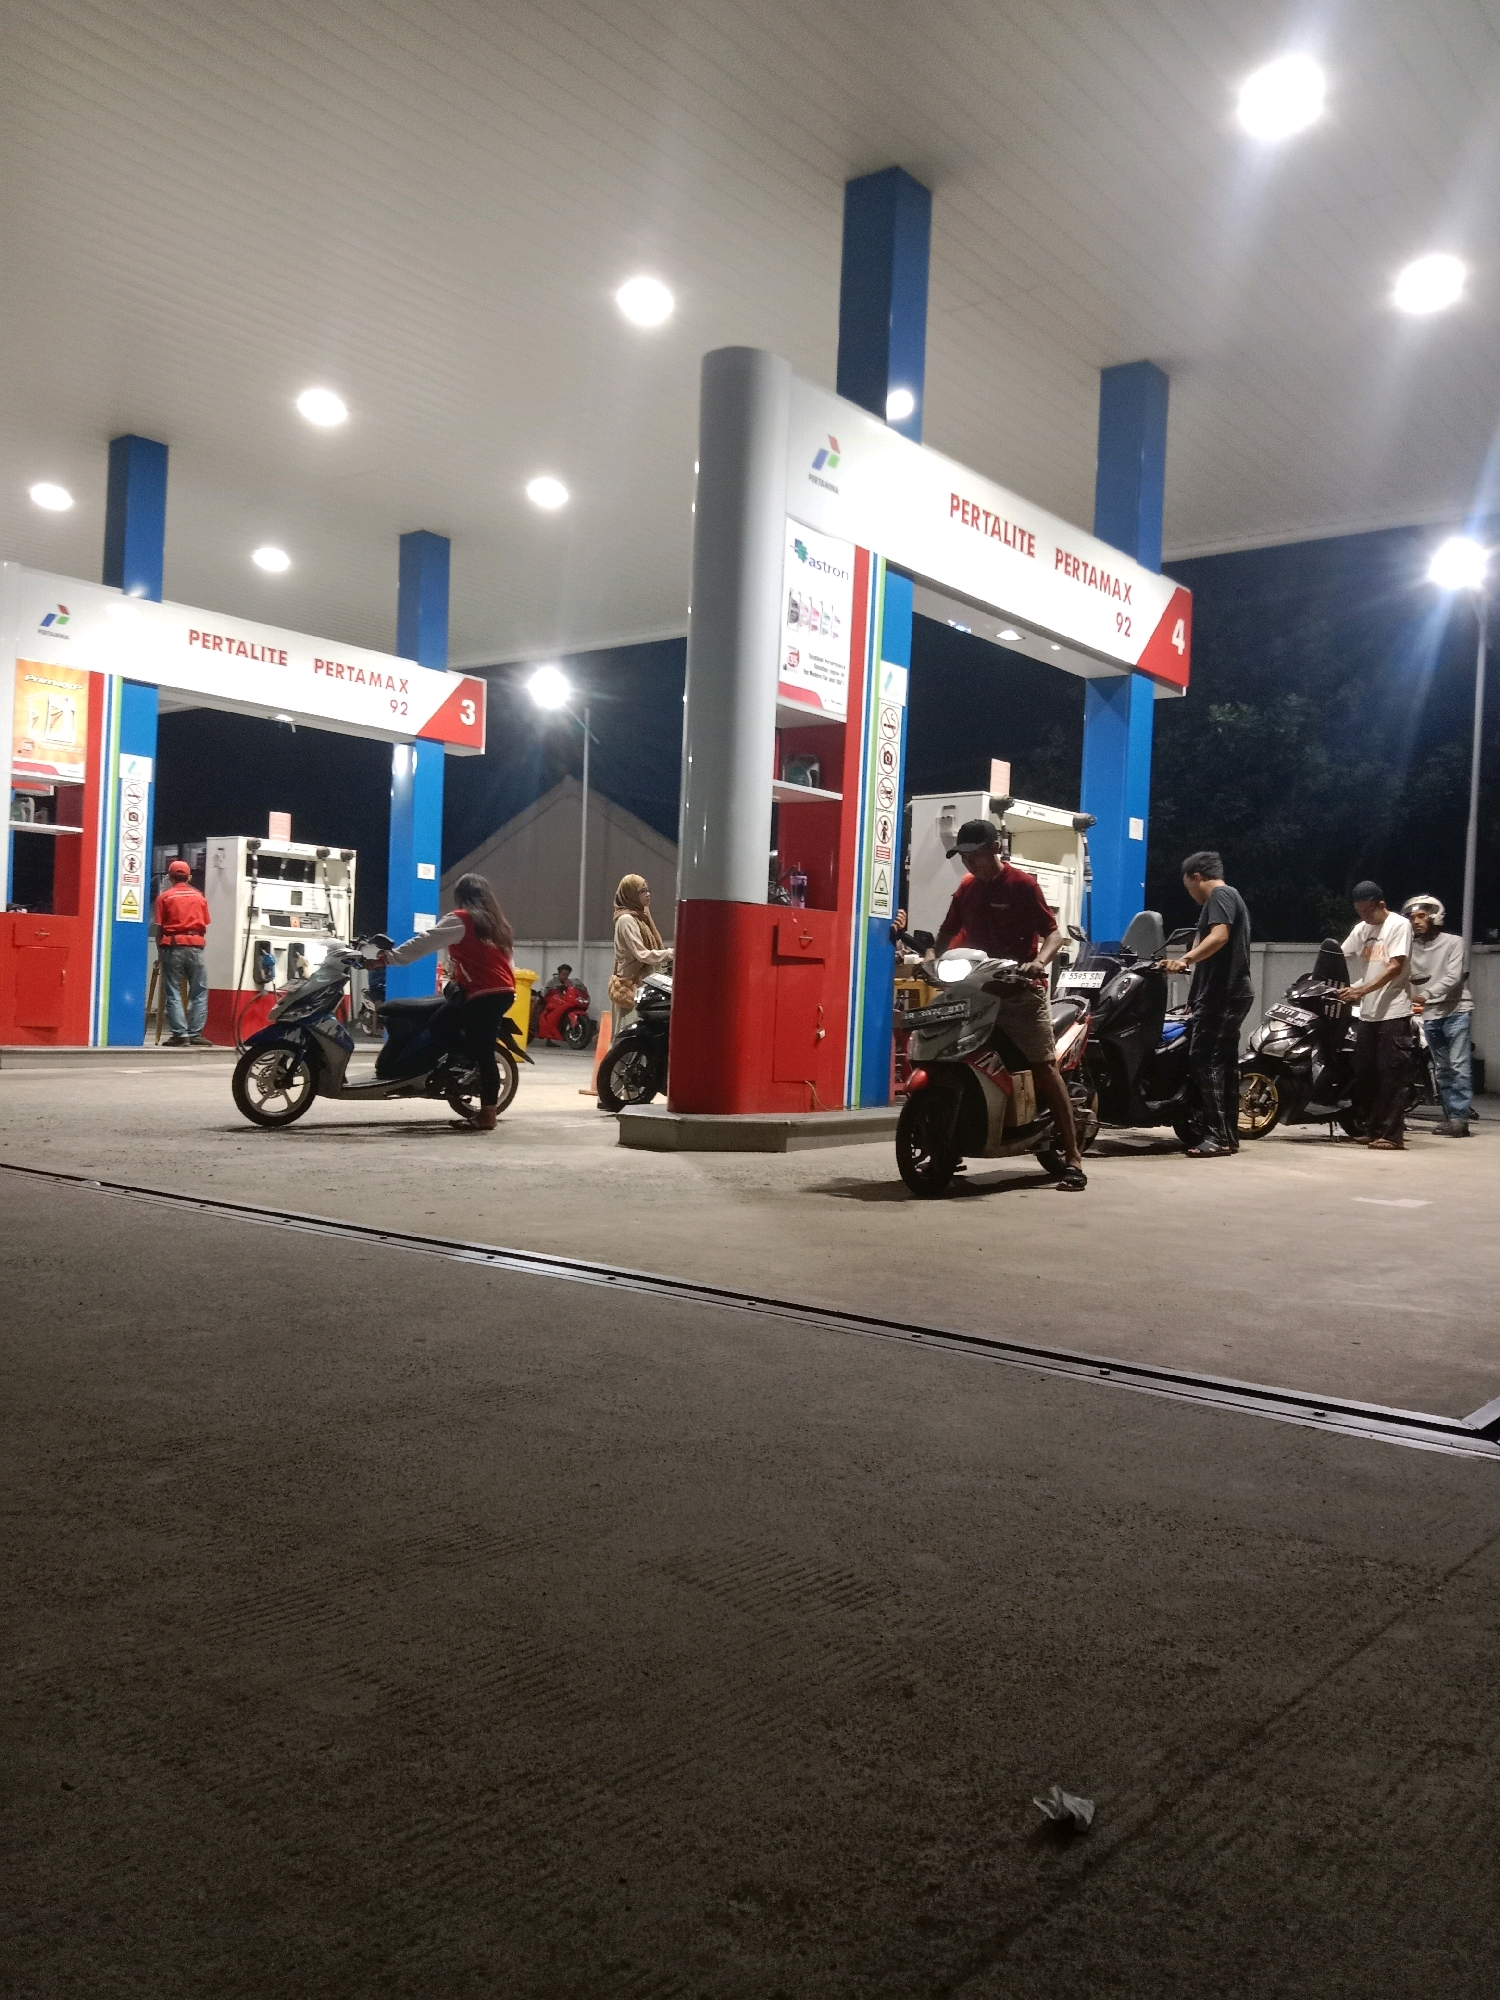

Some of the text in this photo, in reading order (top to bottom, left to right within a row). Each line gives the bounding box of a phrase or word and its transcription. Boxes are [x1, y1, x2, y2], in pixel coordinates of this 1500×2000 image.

[950, 492, 1132, 605] PERTALITE PERTAMAX
[1116, 611, 1132, 638] 92
[1171, 618, 1187, 656] 4
[188, 629, 409, 694] PERTALITE PERTAMAX
[389, 699, 408, 716] 92
[459, 699, 476, 726] 3
